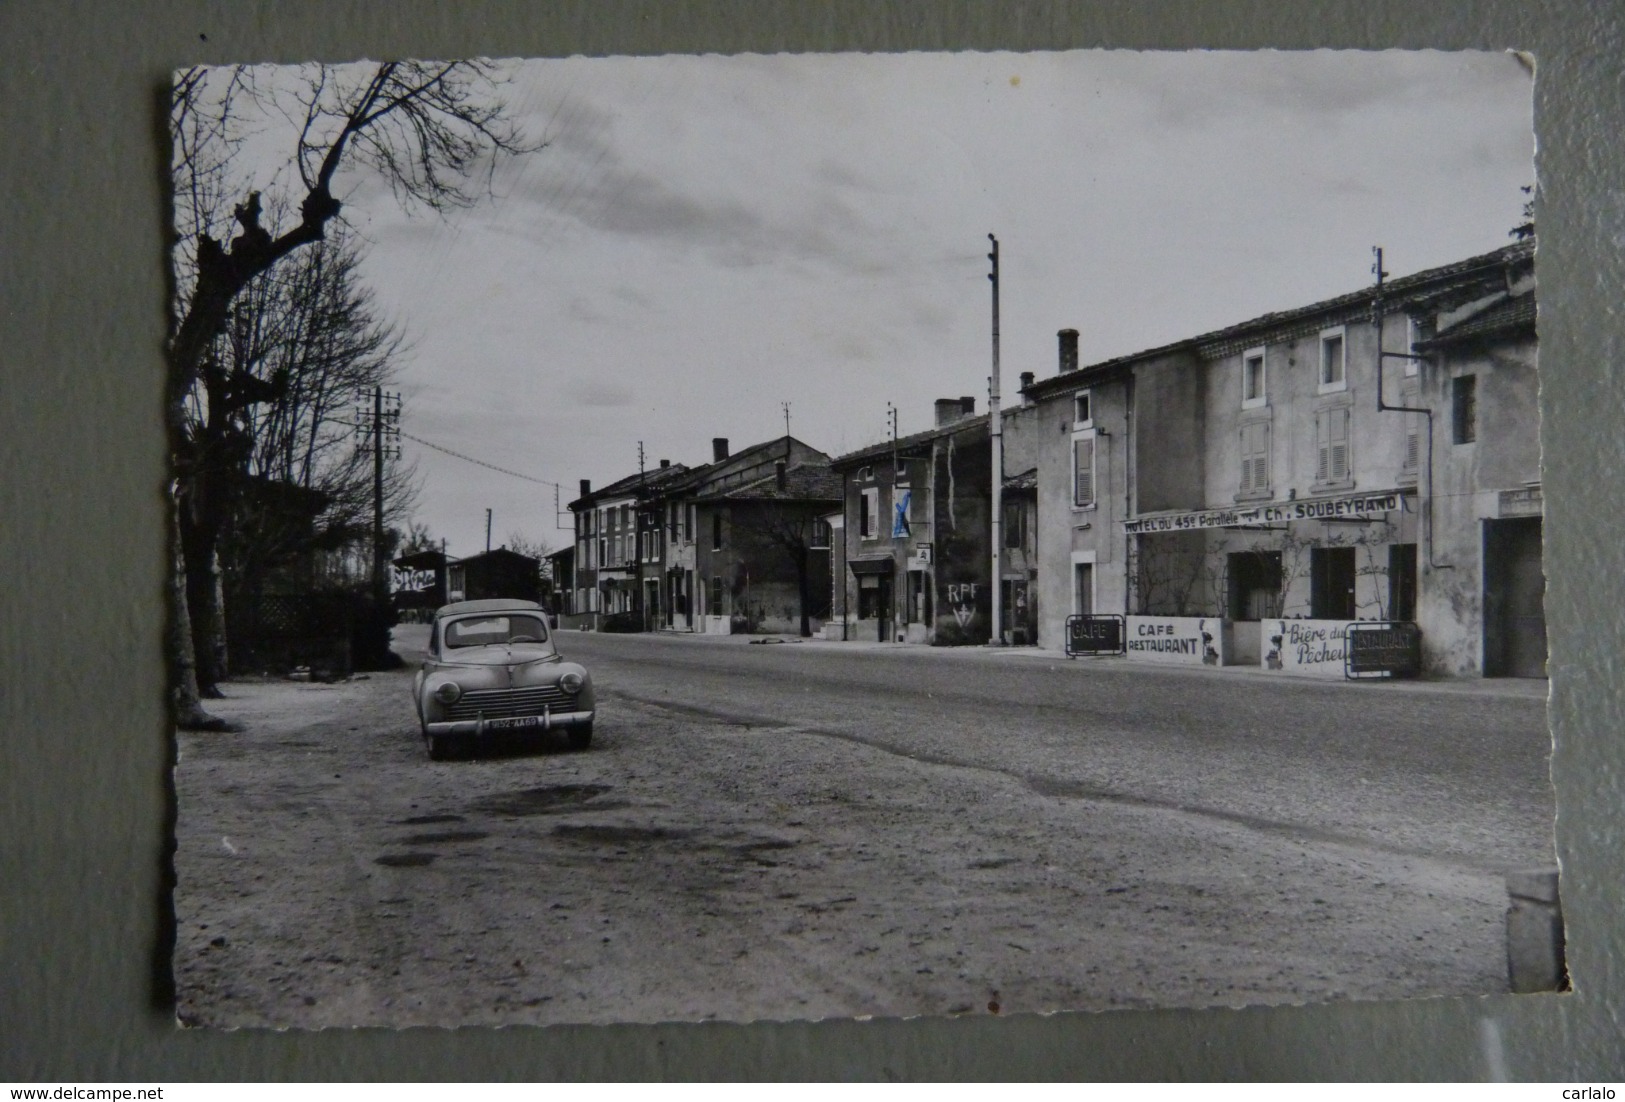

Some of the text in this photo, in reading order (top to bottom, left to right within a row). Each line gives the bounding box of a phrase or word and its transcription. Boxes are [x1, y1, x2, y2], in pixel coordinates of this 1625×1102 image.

[1160, 518, 1172, 530] DU
[1199, 510, 1239, 527] Parallèle
[1295, 496, 1396, 518] SOUBEYRAND
[1138, 624, 1174, 636] CAFÉ
[1287, 624, 1345, 644] Bière du
[1129, 638, 1197, 654] RESTAURANT
